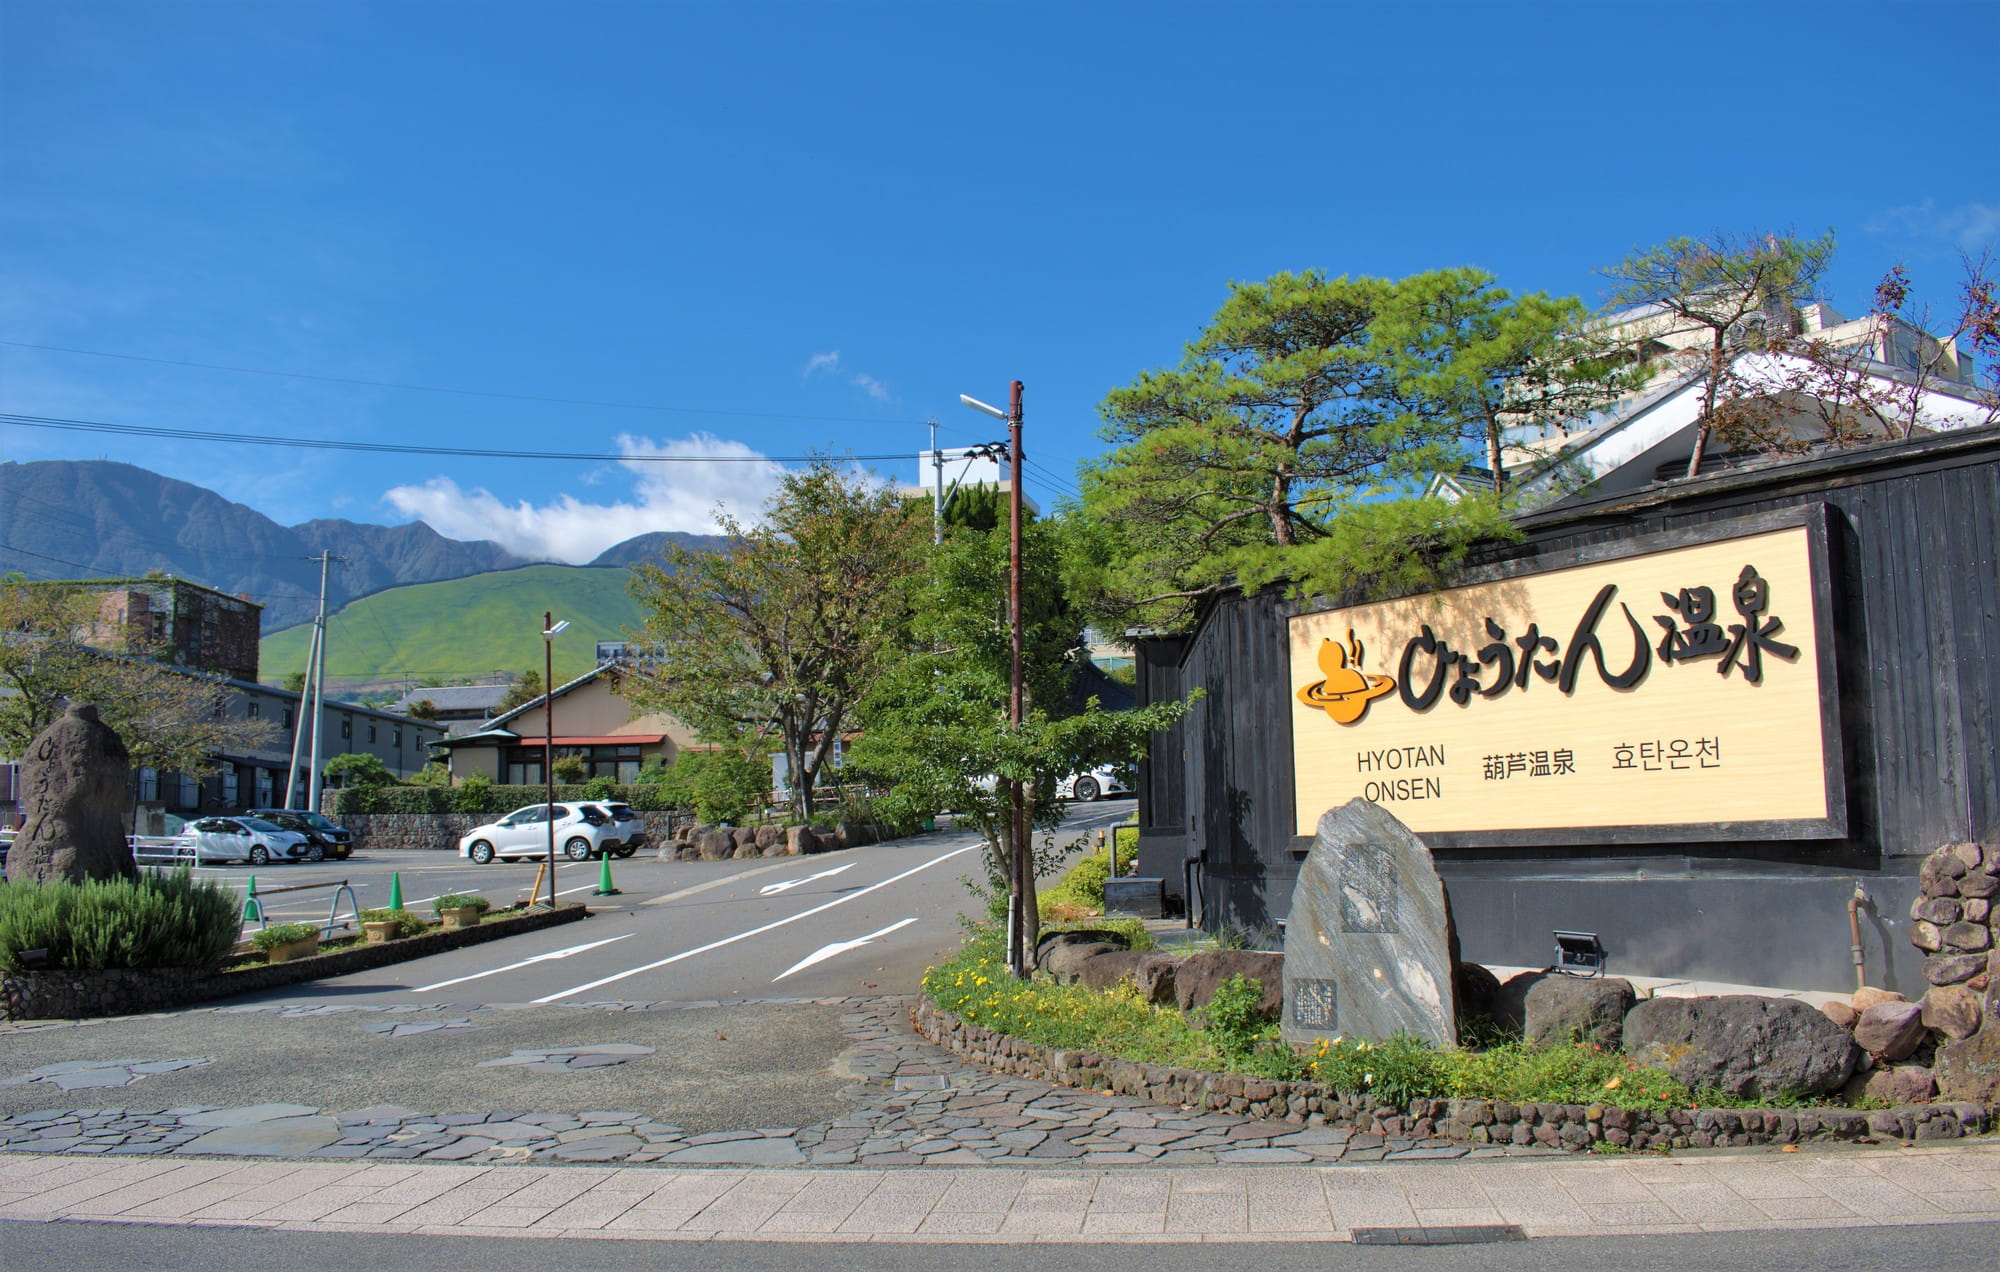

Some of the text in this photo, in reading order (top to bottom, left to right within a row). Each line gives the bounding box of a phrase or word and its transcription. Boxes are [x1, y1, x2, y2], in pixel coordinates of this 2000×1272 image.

[1398, 564, 1799, 710] ひょうたん温泉
[1358, 744, 1445, 773] HYOTAN
[1482, 748, 1576, 781] 葫芦温泉
[1612, 736, 1721, 772] 효탄온천
[1364, 777, 1441, 803] ONSEN
